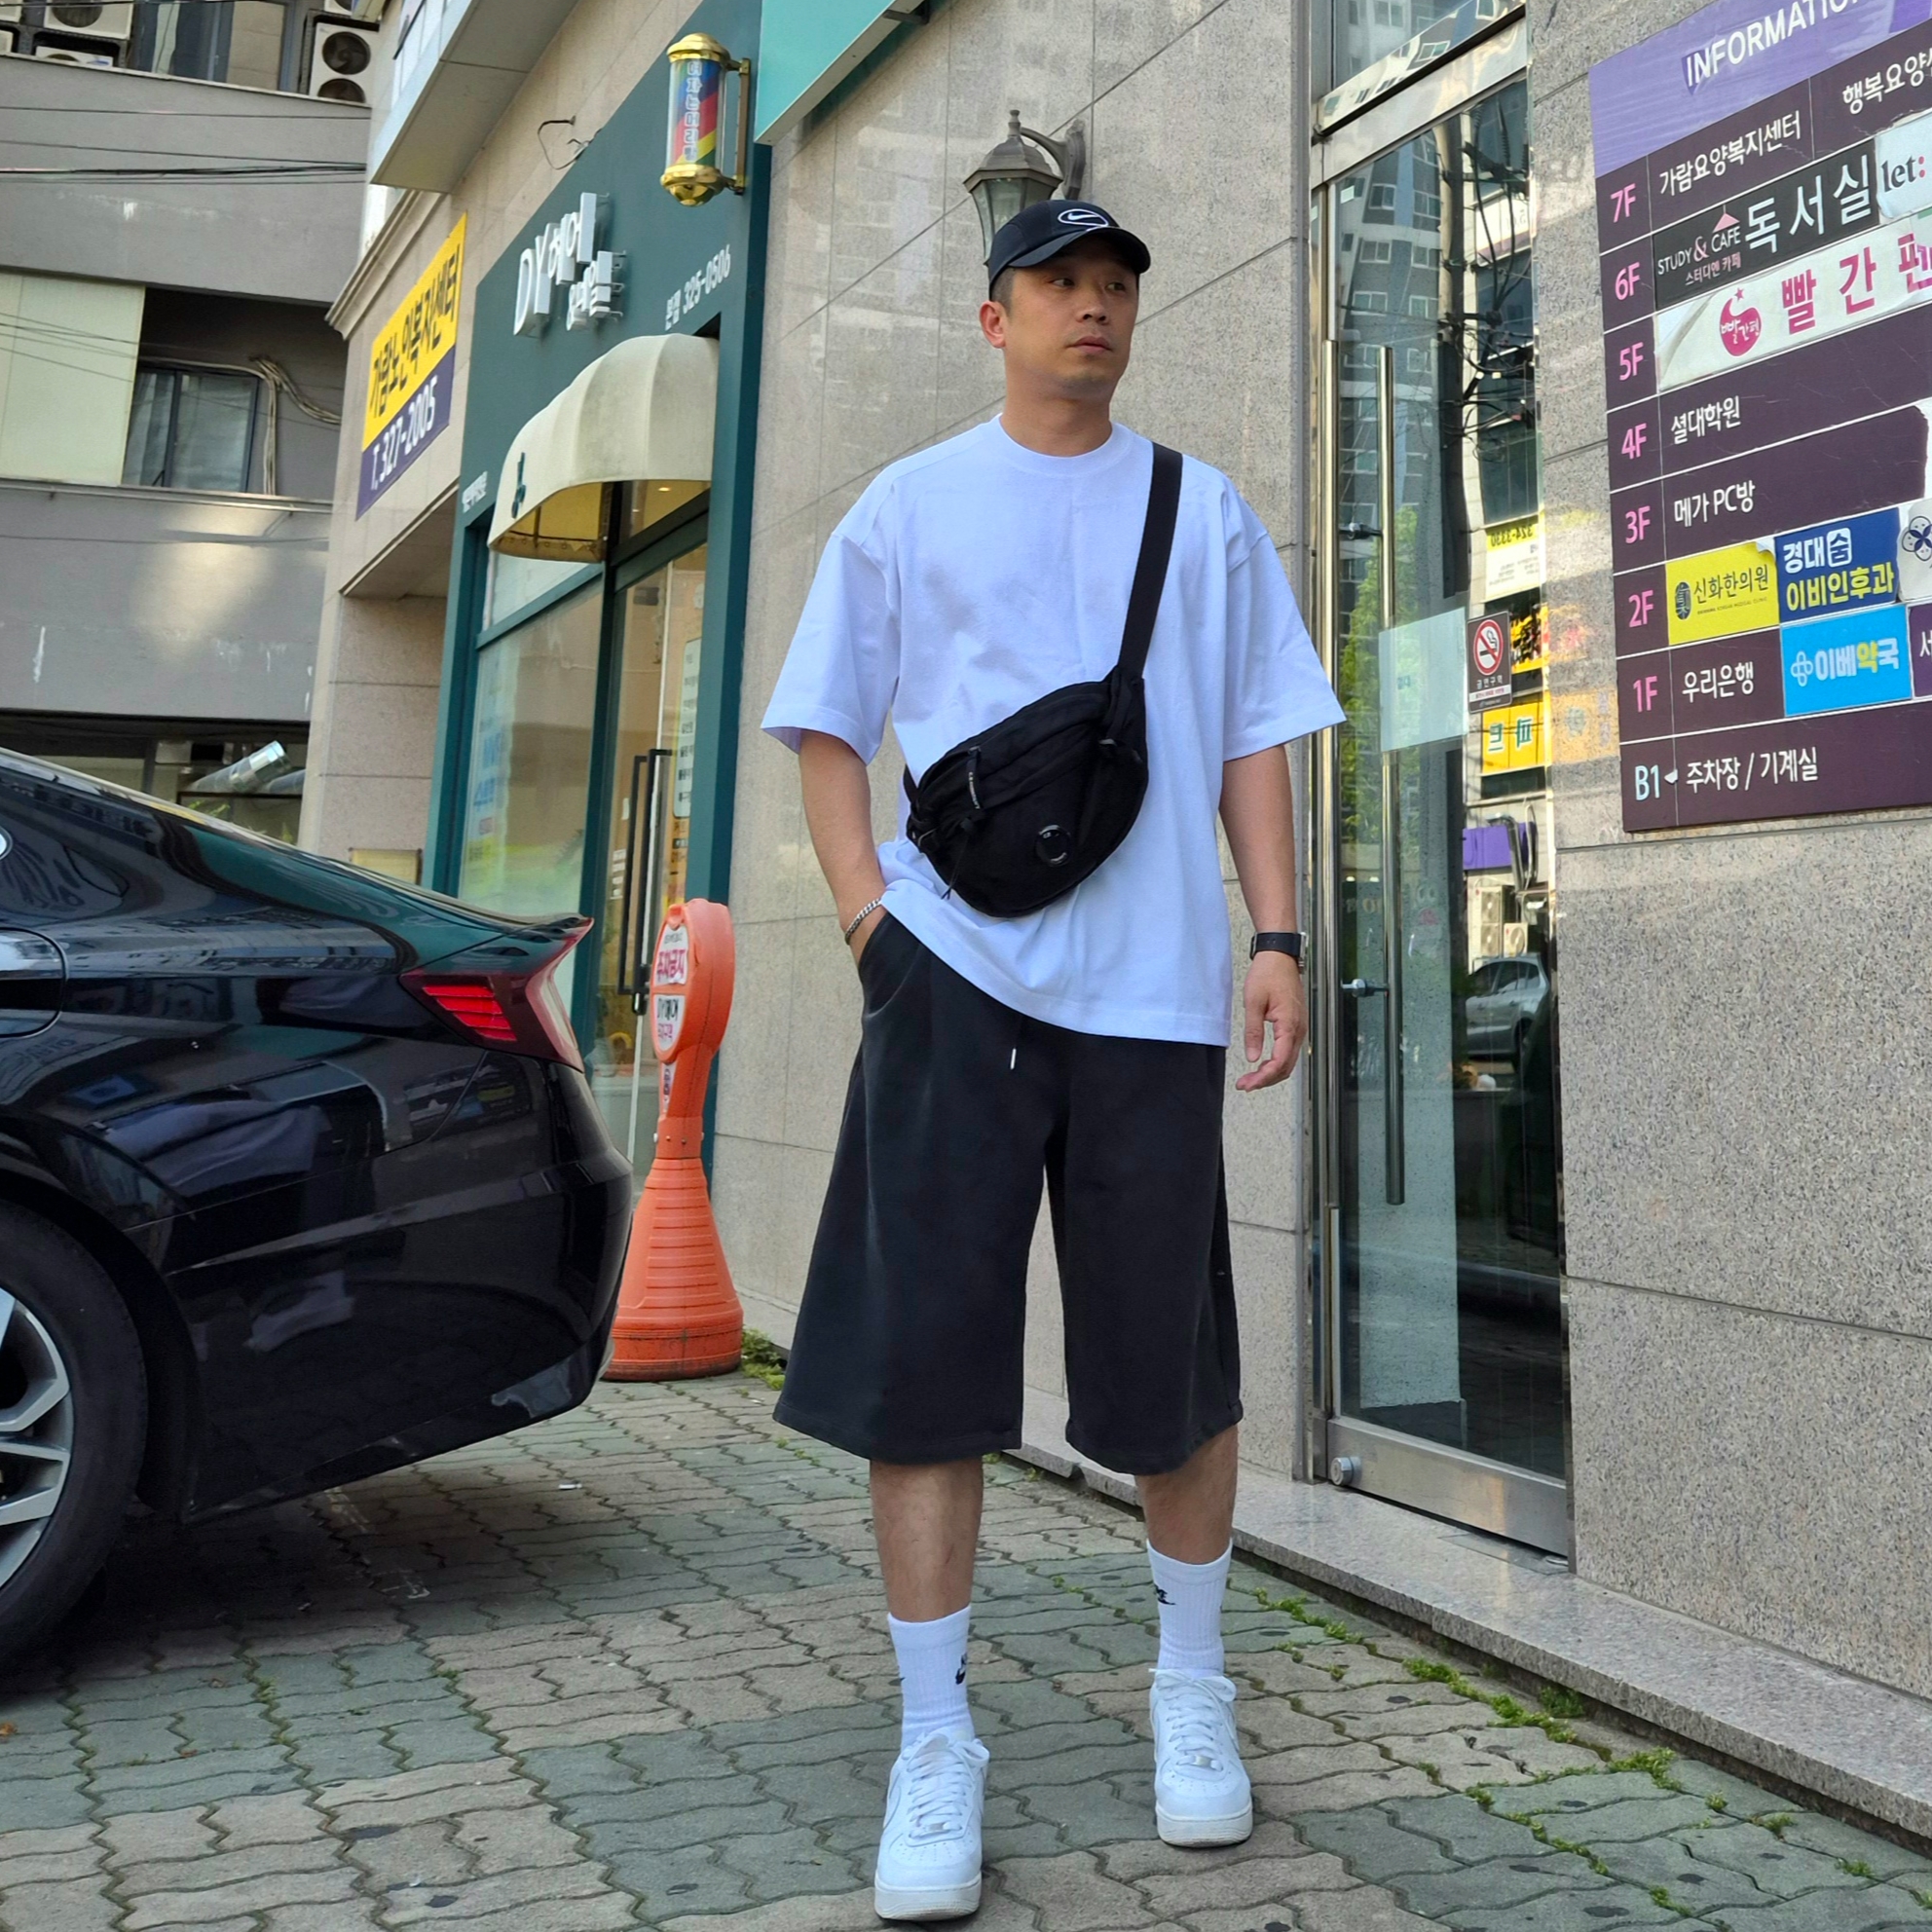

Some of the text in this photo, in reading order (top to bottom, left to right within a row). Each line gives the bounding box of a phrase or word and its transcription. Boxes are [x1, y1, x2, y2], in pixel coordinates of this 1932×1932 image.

[1659, 110, 1801, 196] 가람요양복지센터
[1611, 183, 1636, 222] 7F
[1657, 226, 1741, 275] STUDY & CAFE
[1722, 251, 1741, 273] 카페
[1615, 262, 1640, 300] 6F
[1619, 342, 1644, 381] 5F
[1621, 423, 1647, 460] 4F
[1674, 480, 1756, 527] 메가 PC방
[1625, 505, 1651, 543] 3F
[1694, 564, 1768, 604] 신화한의원
[1786, 562, 1894, 611] 이비인후과
[1628, 590, 1653, 627] 2F
[1815, 638, 1899, 681] 이베약국
[1633, 676, 1657, 712] 1F
[1682, 661, 1754, 703] 우리은행
[1635, 764, 1659, 800] B1
[1686, 747, 1818, 794] 주차장 / 기계실
